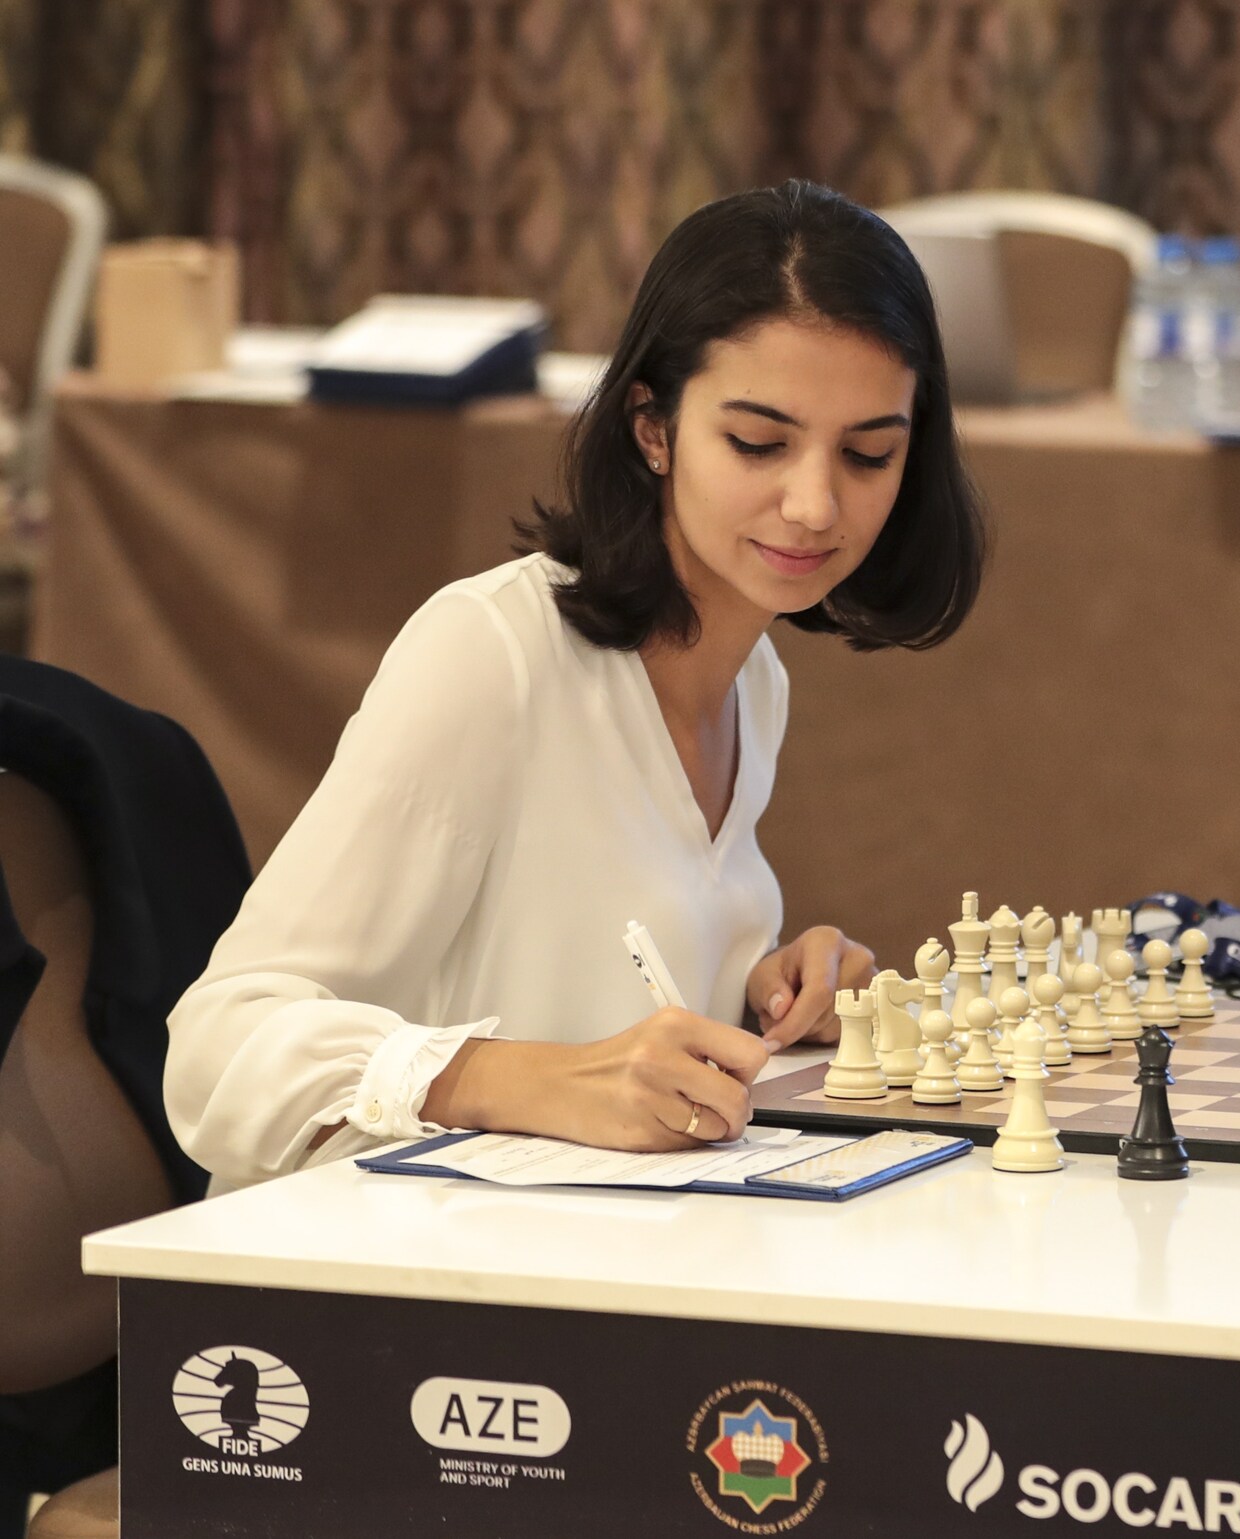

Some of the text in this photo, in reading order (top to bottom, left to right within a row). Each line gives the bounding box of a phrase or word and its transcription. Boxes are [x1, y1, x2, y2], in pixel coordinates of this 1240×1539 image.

[439, 1393, 538, 1443] AZE
[222, 1437, 258, 1457] FIDE
[182, 1457, 303, 1482] GENS UNA SUMUS
[439, 1457, 566, 1481] MINISTRY OF YOUTH
[440, 1472, 511, 1489] AND SPORT
